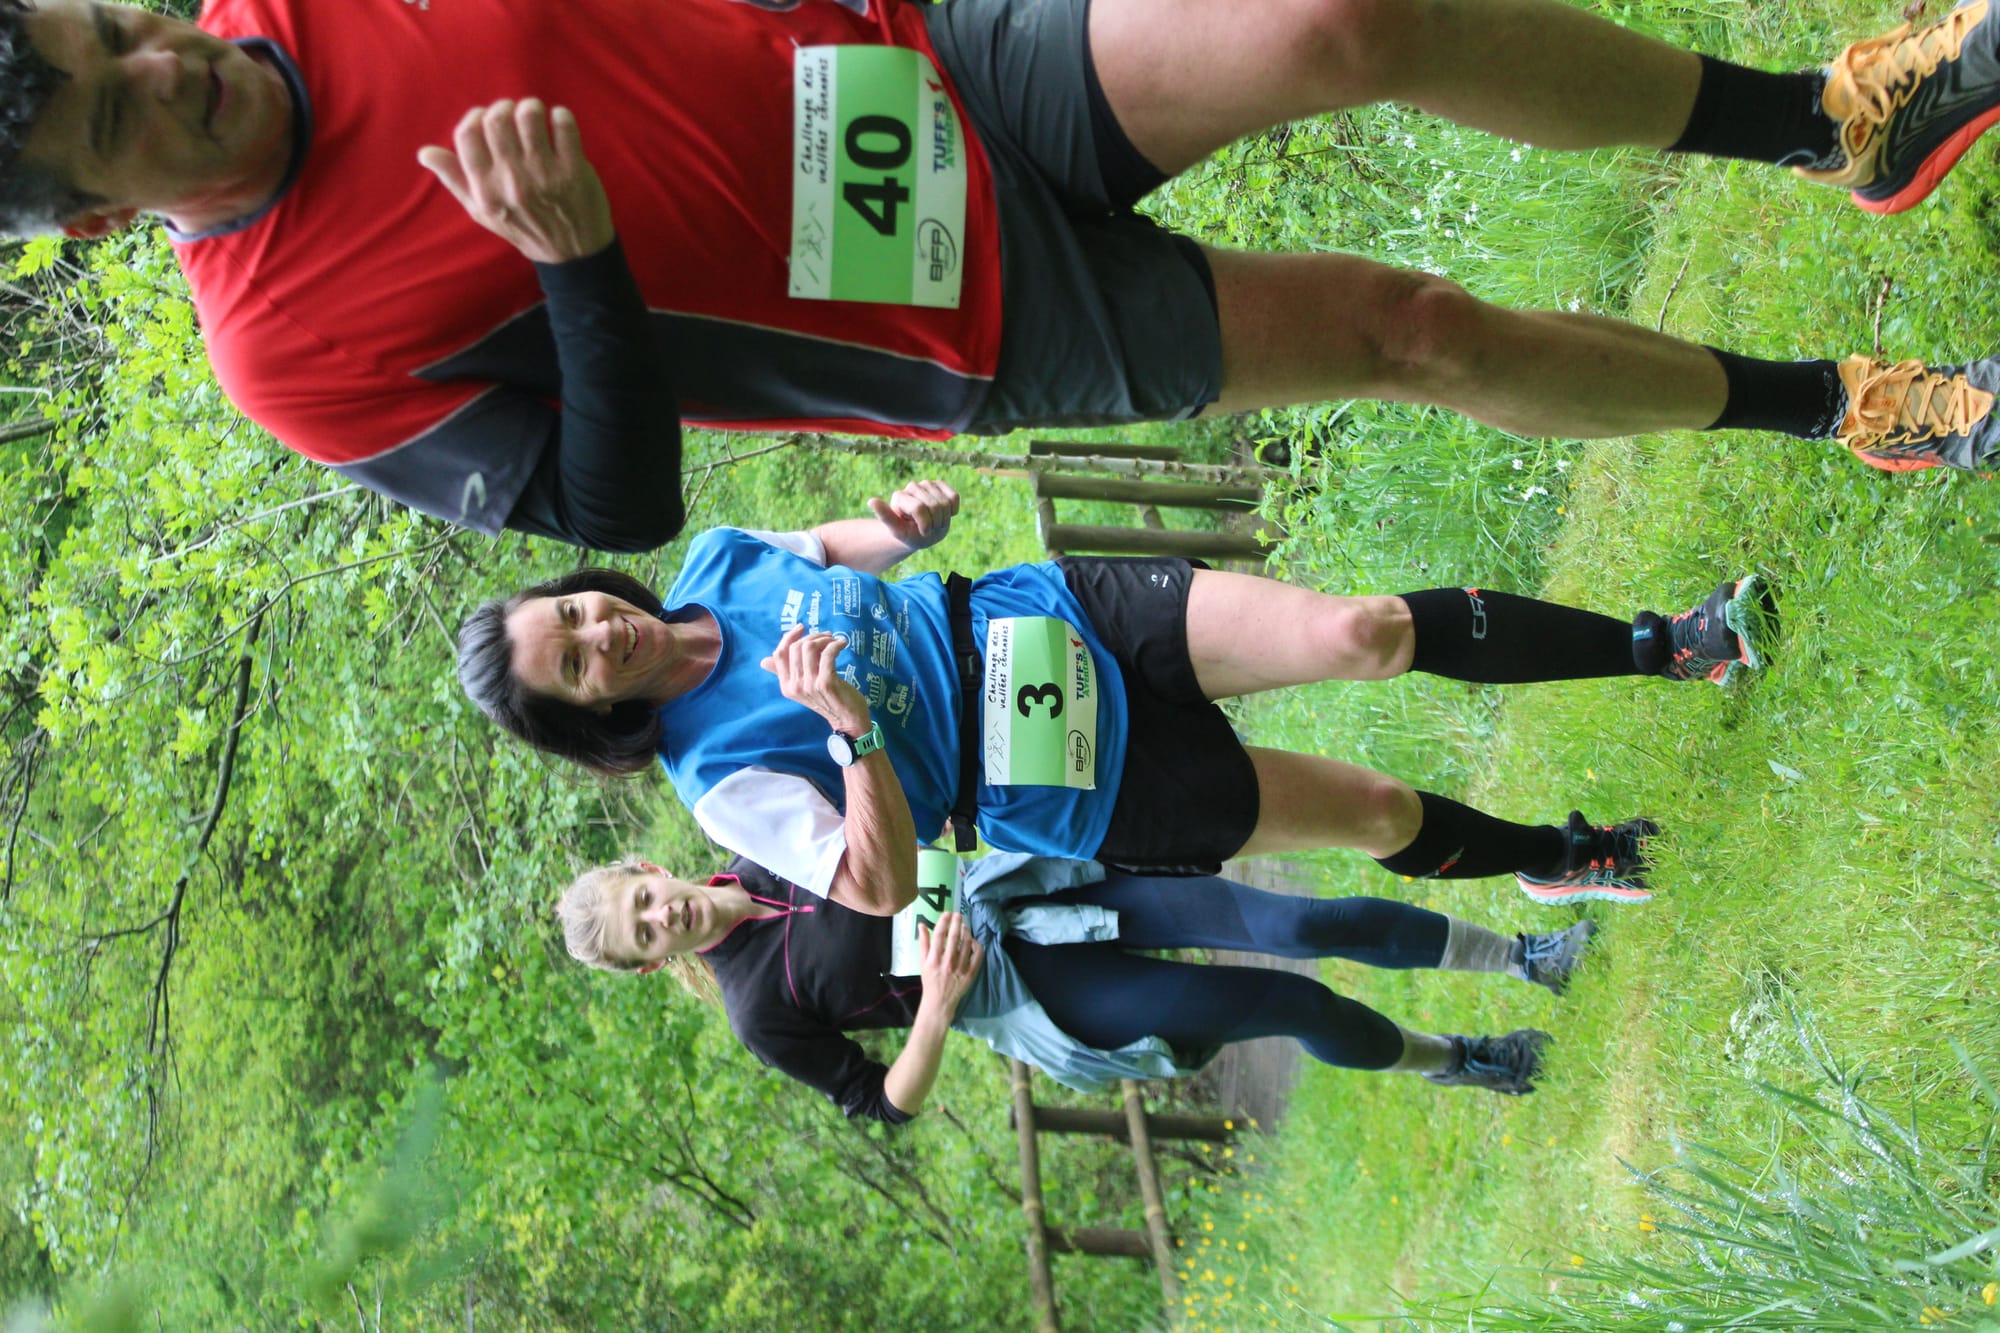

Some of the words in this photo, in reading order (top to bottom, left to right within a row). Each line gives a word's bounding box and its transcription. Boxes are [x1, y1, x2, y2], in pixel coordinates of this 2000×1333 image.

[802, 66, 813, 88] des
[814, 57, 829, 120] cévenoles
[801, 96, 819, 174] Challenge
[816, 129, 829, 183] vallées
[933, 102, 946, 173] TUFF'S
[843, 115, 912, 236] 40
[930, 229, 944, 281] BFP
[781, 589, 805, 631] UZE
[1000, 625, 1008, 667] cévenoles
[988, 652, 998, 703] Challenge
[998, 673, 1007, 709] vallées
[1017, 682, 1064, 719] 3
[1076, 653, 1084, 700] TUFF'S
[915, 884, 951, 940] 74
